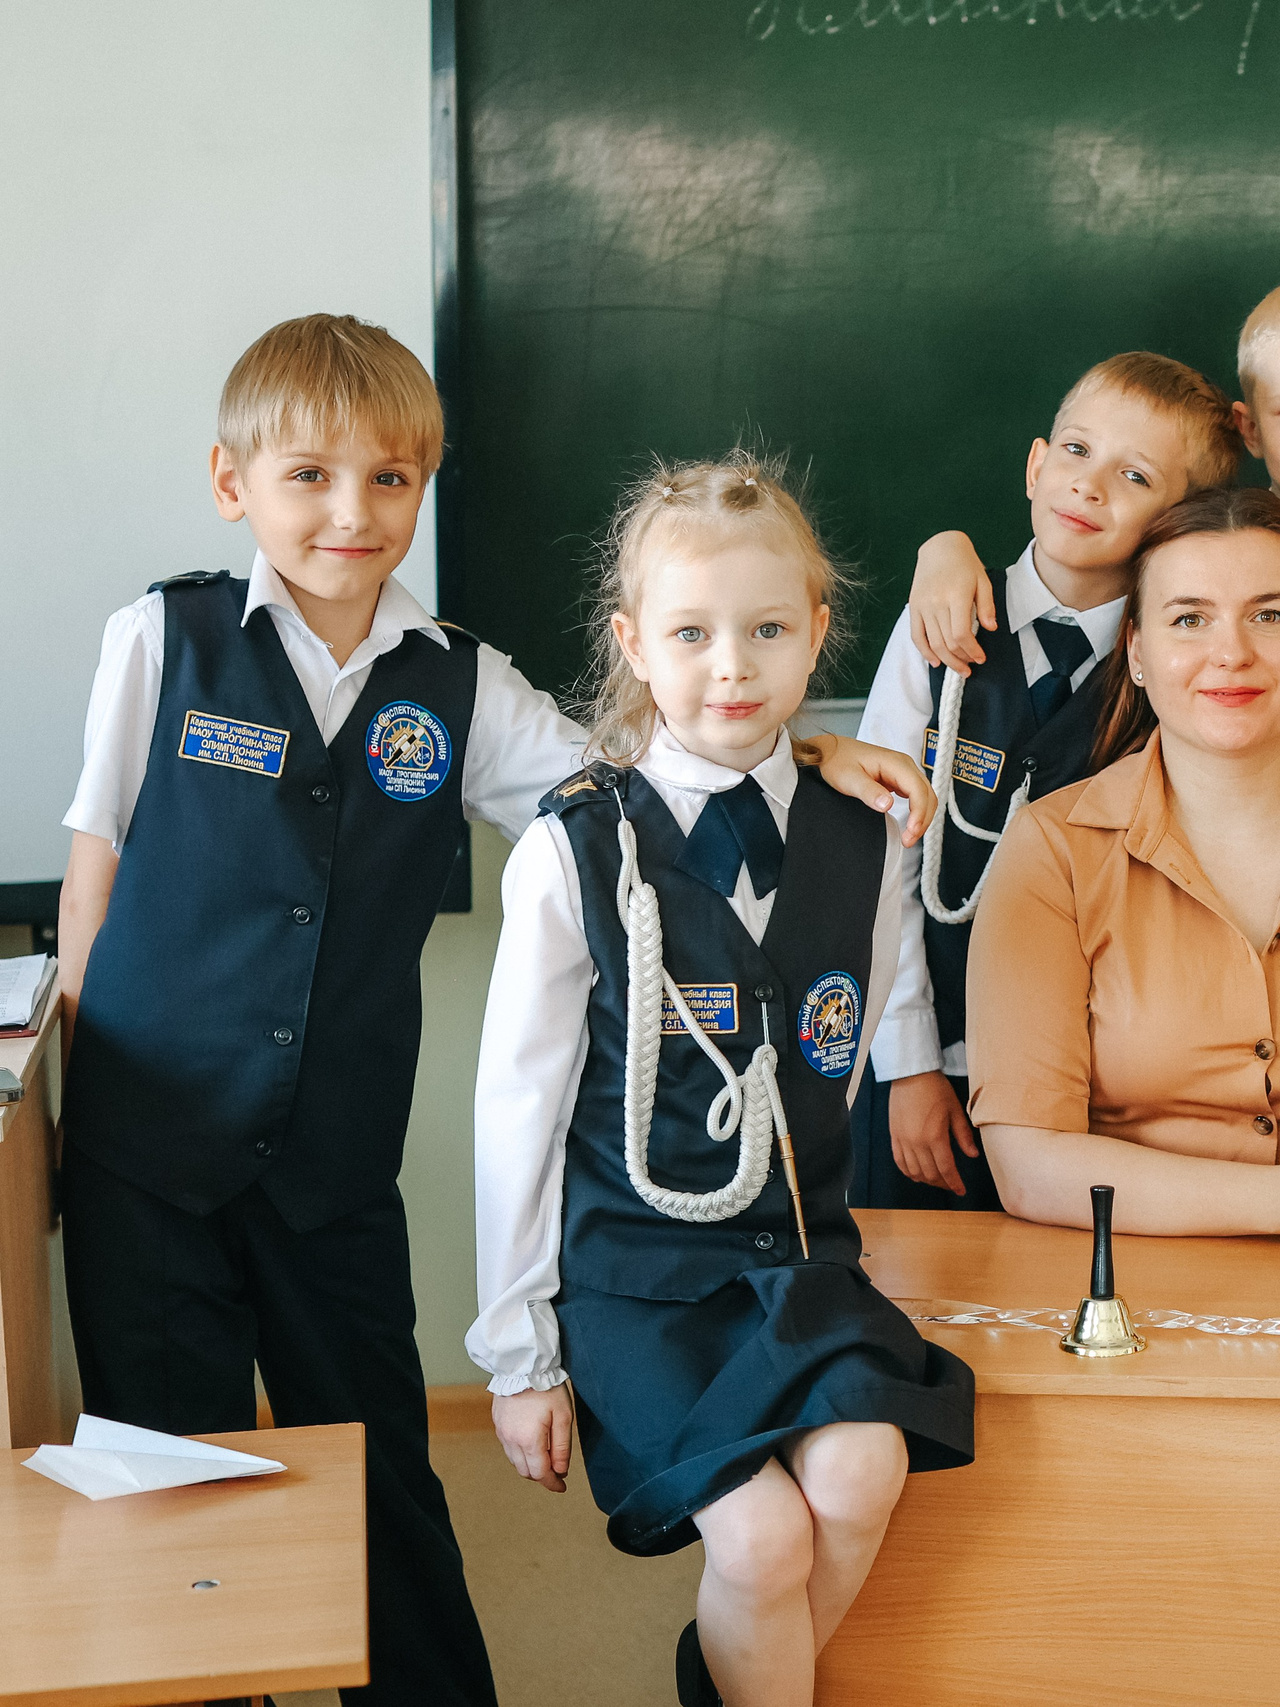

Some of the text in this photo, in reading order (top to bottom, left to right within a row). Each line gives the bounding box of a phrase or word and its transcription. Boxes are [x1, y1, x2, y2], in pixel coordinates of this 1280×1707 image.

[189, 725, 281, 753] МАОУ "ПРОГИМНАЗИЯ
[371, 705, 447, 760] ЮНЫЙ ИНСПЕКТОР ДВИЖЕНИЯ
[201, 739, 268, 760] ОЛИМПИОНИК"
[213, 751, 230, 762] С.П.
[231, 754, 264, 770] Лисина
[802, 1004, 812, 1037] ЮНЫЙ
[809, 976, 844, 1002] ИНСПЕКТОР
[665, 1020, 682, 1029] С.П.
